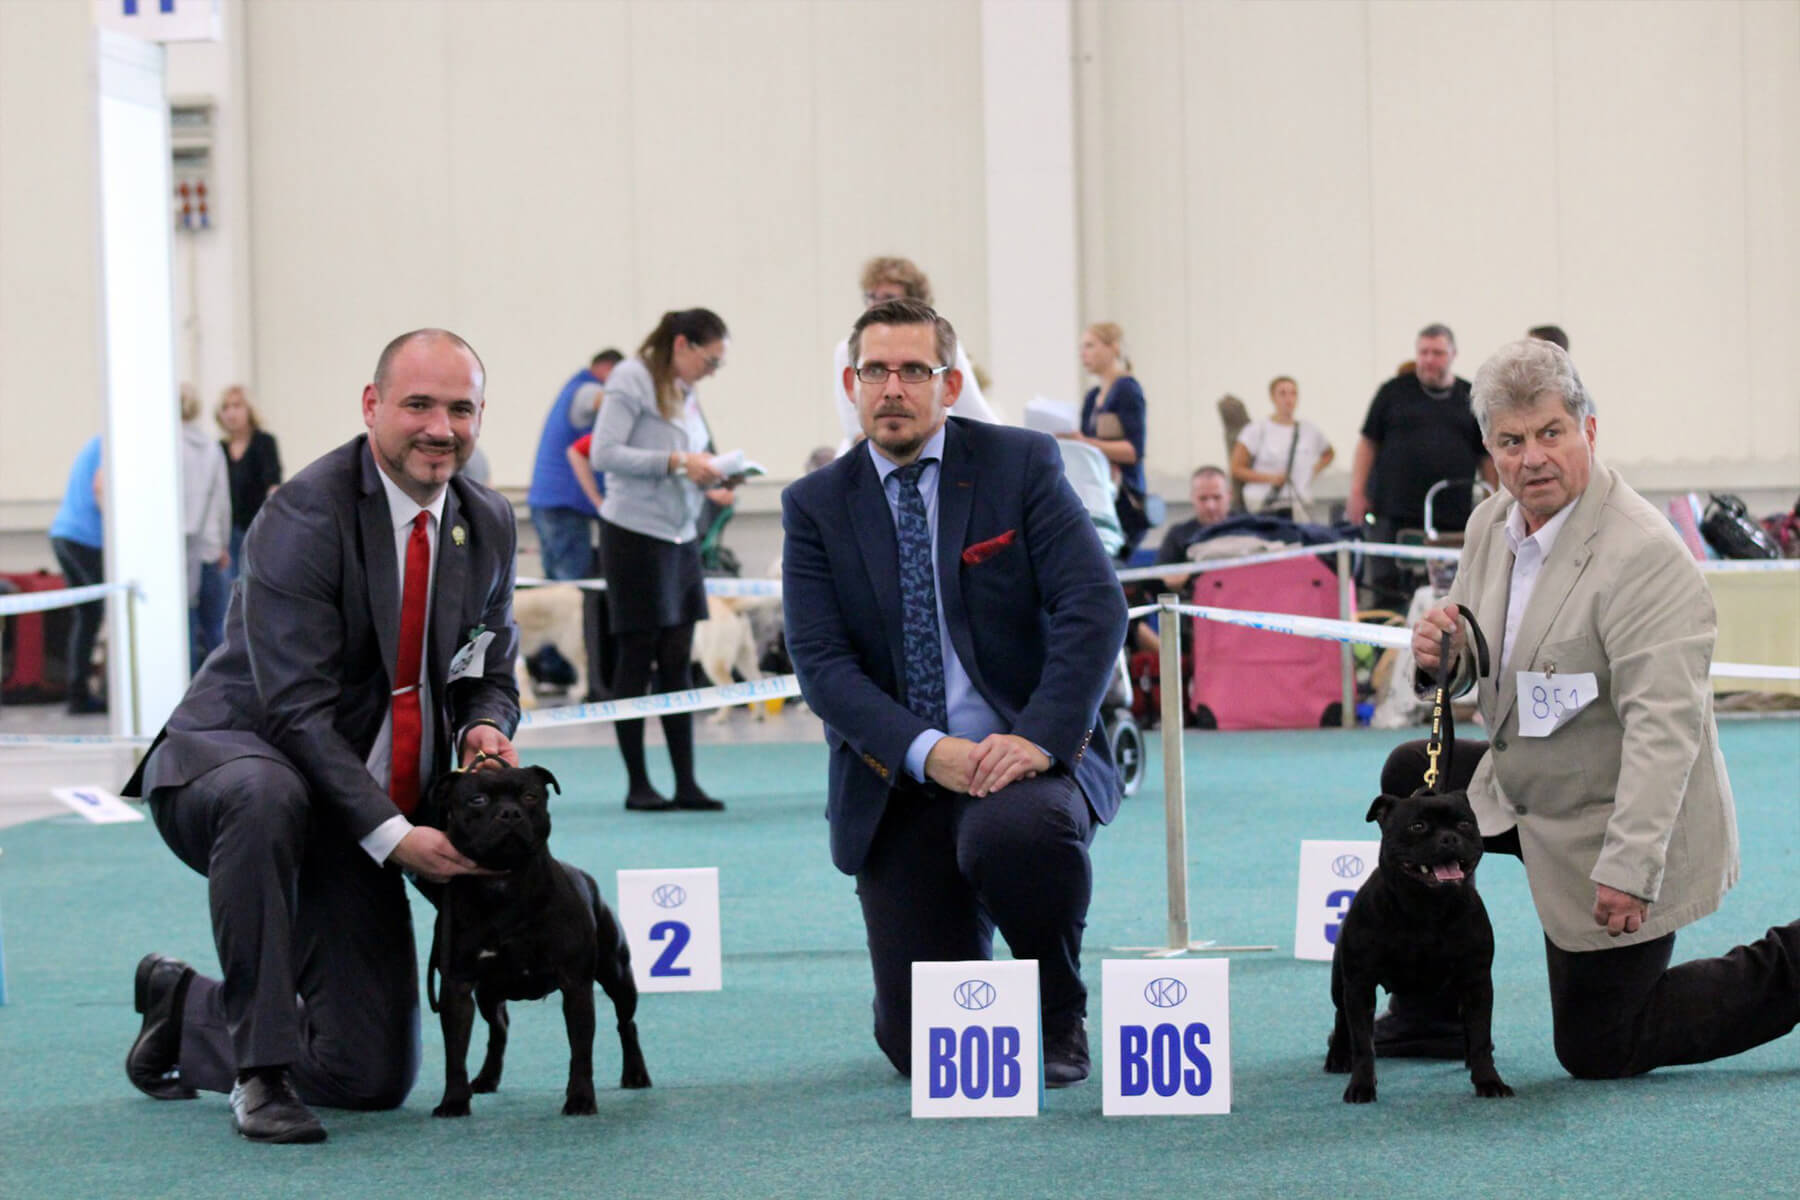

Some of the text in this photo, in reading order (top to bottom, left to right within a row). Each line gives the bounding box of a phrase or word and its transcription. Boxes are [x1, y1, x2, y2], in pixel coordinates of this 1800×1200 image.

[1532, 686, 1579, 719] 851
[648, 920, 691, 977] 2
[929, 1025, 1021, 1100] BOB
[1119, 1022, 1212, 1097] BOS
